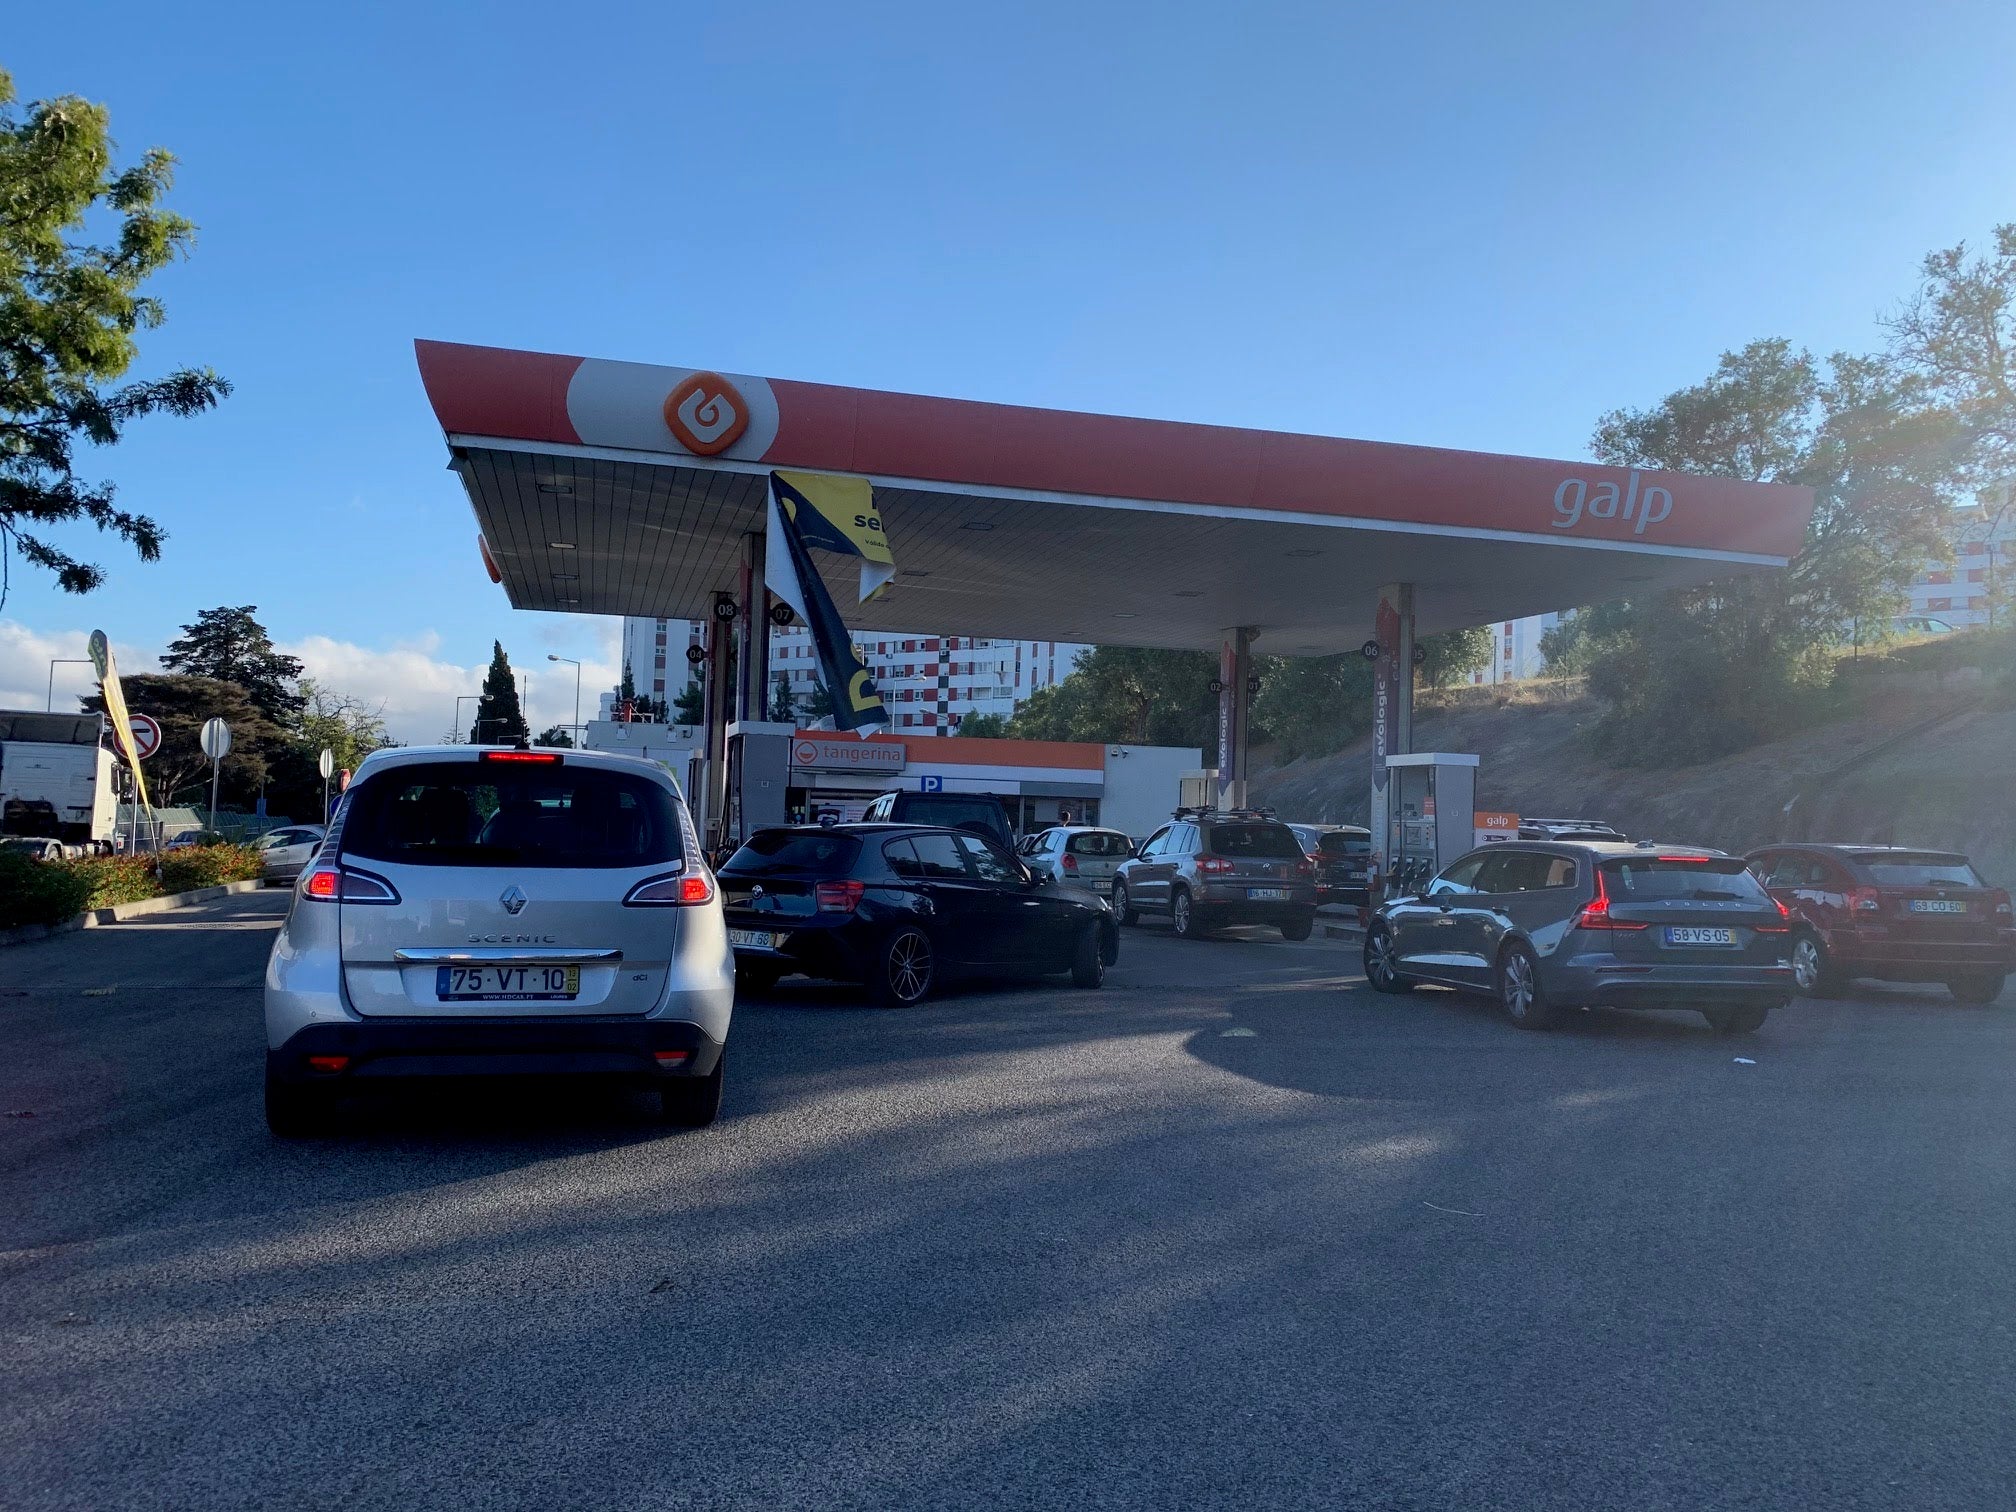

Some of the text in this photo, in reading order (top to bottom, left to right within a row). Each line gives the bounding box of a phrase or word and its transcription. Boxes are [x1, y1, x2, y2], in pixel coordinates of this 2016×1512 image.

[1551, 470, 1674, 535] galp
[854, 514, 886, 533] se
[718, 604, 734, 615] 08
[775, 608, 790, 619] 07
[1364, 645, 1378, 656] 06
[1376, 680, 1388, 756] evologic
[1220, 707, 1228, 768] evologic
[823, 745, 900, 763] tangerina
[925, 776, 938, 792] P
[1486, 815, 1509, 827] galp
[468, 933, 557, 944] SCENIC
